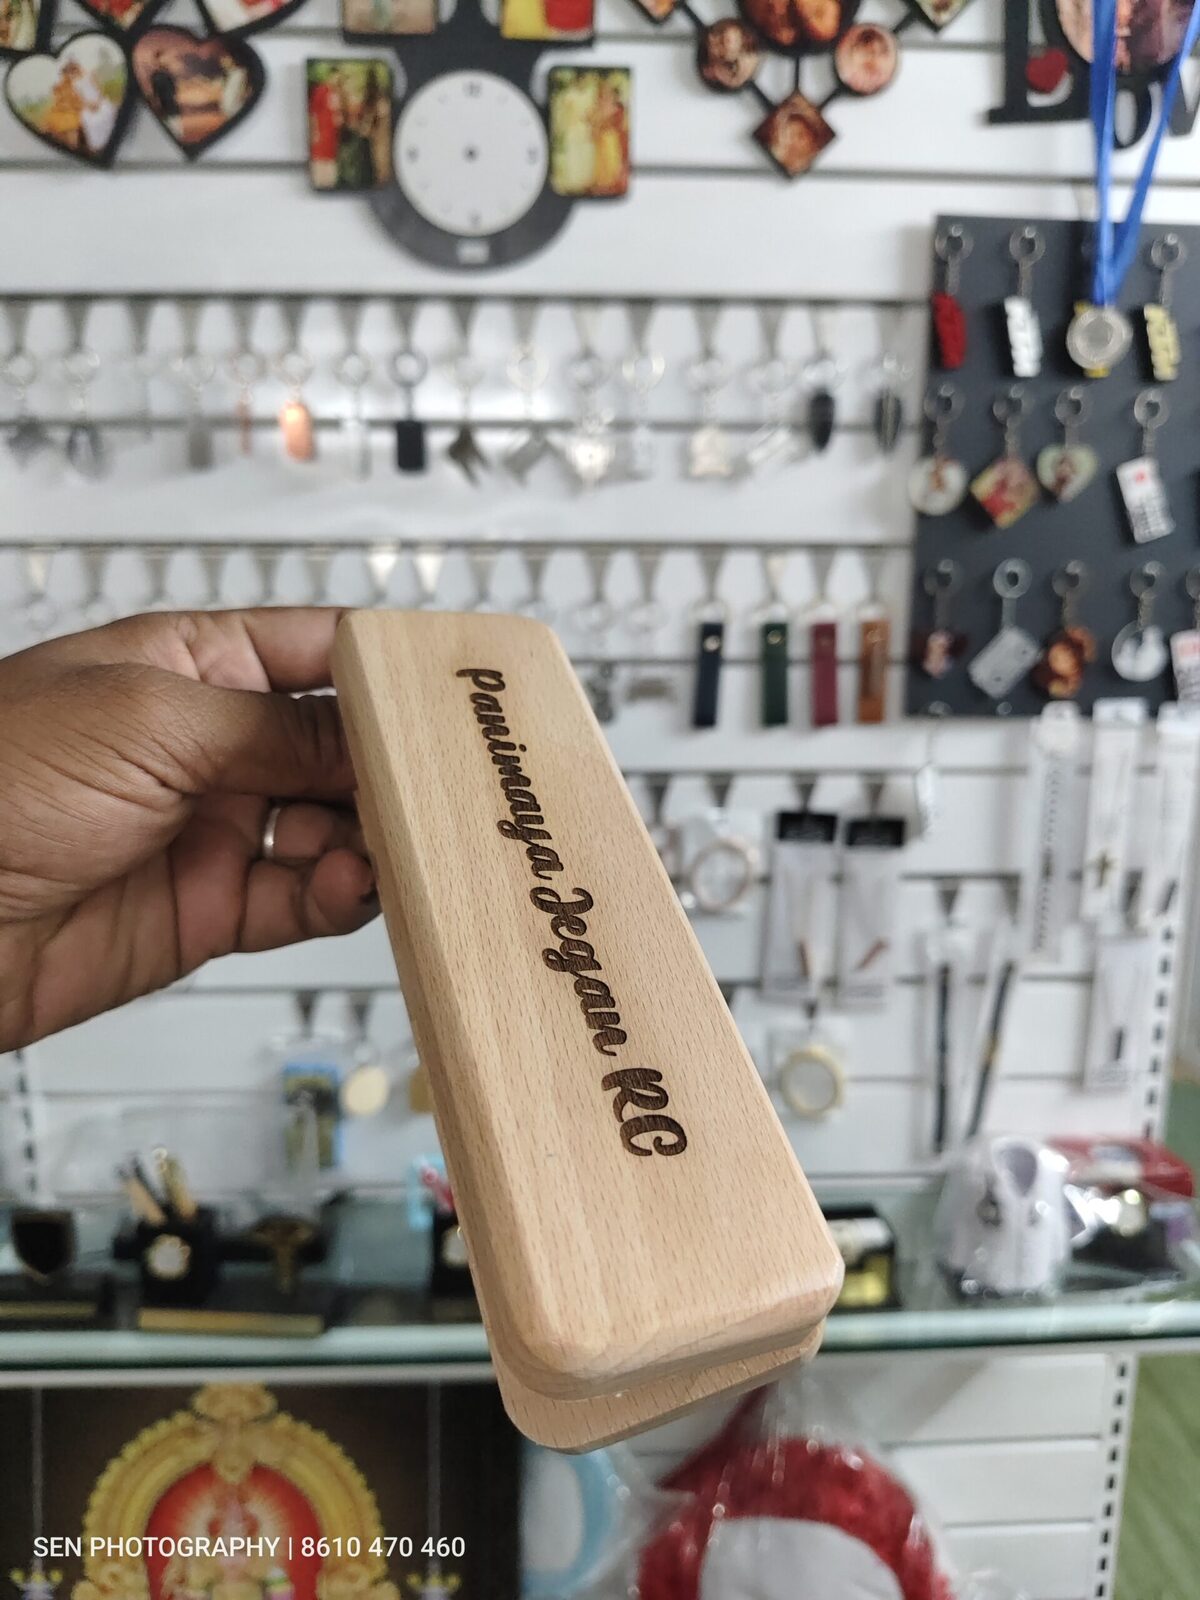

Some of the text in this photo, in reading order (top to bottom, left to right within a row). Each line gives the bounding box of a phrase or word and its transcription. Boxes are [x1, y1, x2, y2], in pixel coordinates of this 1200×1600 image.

[456, 668, 688, 1157] Panimaya Jegan RC
